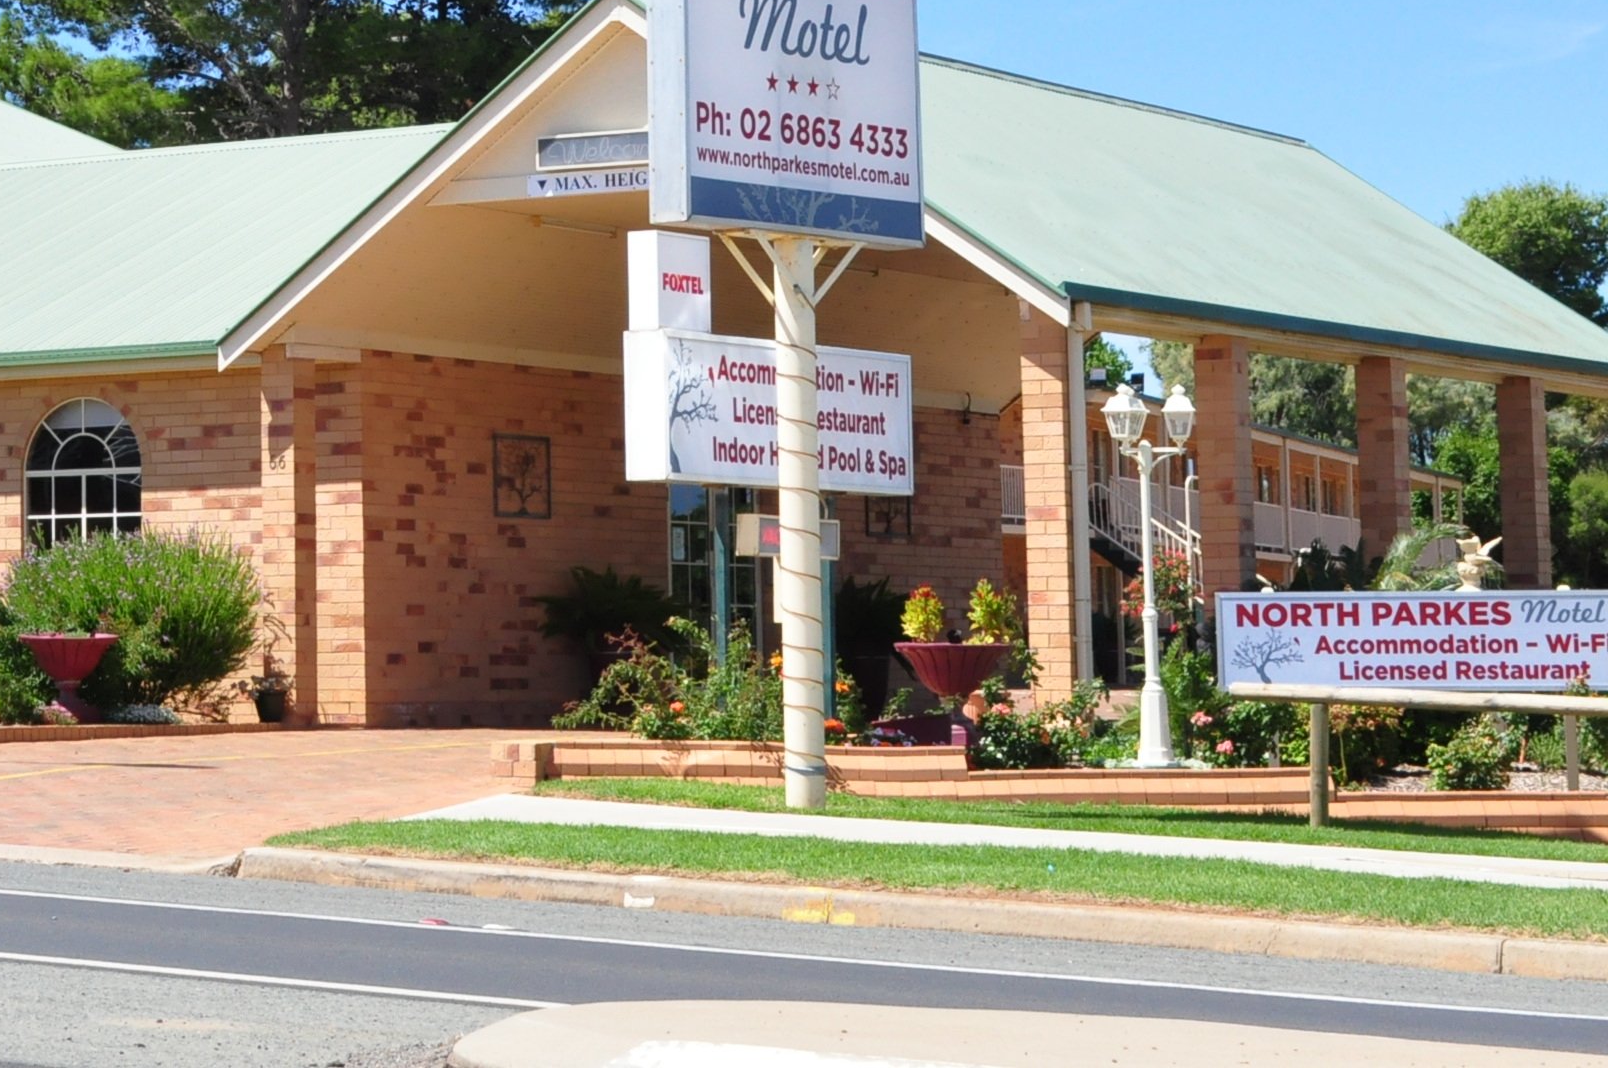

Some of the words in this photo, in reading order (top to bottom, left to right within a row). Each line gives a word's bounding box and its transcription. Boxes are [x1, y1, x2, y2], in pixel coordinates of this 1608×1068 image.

[696, 100, 732, 137] Ph:
[740, 107, 772, 142] 02
[780, 112, 841, 150] 6863
[849, 122, 908, 159] 4333
[554, 174, 598, 192] MAX.
[604, 170, 648, 188] HEIG
[696, 146, 910, 187] www.northparkesmotel.com.au
[662, 272, 704, 295] FOXTEL
[859, 369, 899, 399] Wi-Fi
[816, 407, 886, 436] estaurant
[712, 435, 765, 466] Indoor
[828, 445, 861, 473] Pool
[864, 448, 875, 474] &
[878, 449, 907, 481] Spa
[1235, 602, 1358, 628] NORTH
[1371, 600, 1513, 627] PARKES
[1520, 599, 1606, 624] Motel
[1314, 633, 1519, 654] Accommodation
[1545, 633, 1608, 654] Wi-F
[1339, 660, 1448, 681] Licensed
[1455, 660, 1591, 681] Restaurant
